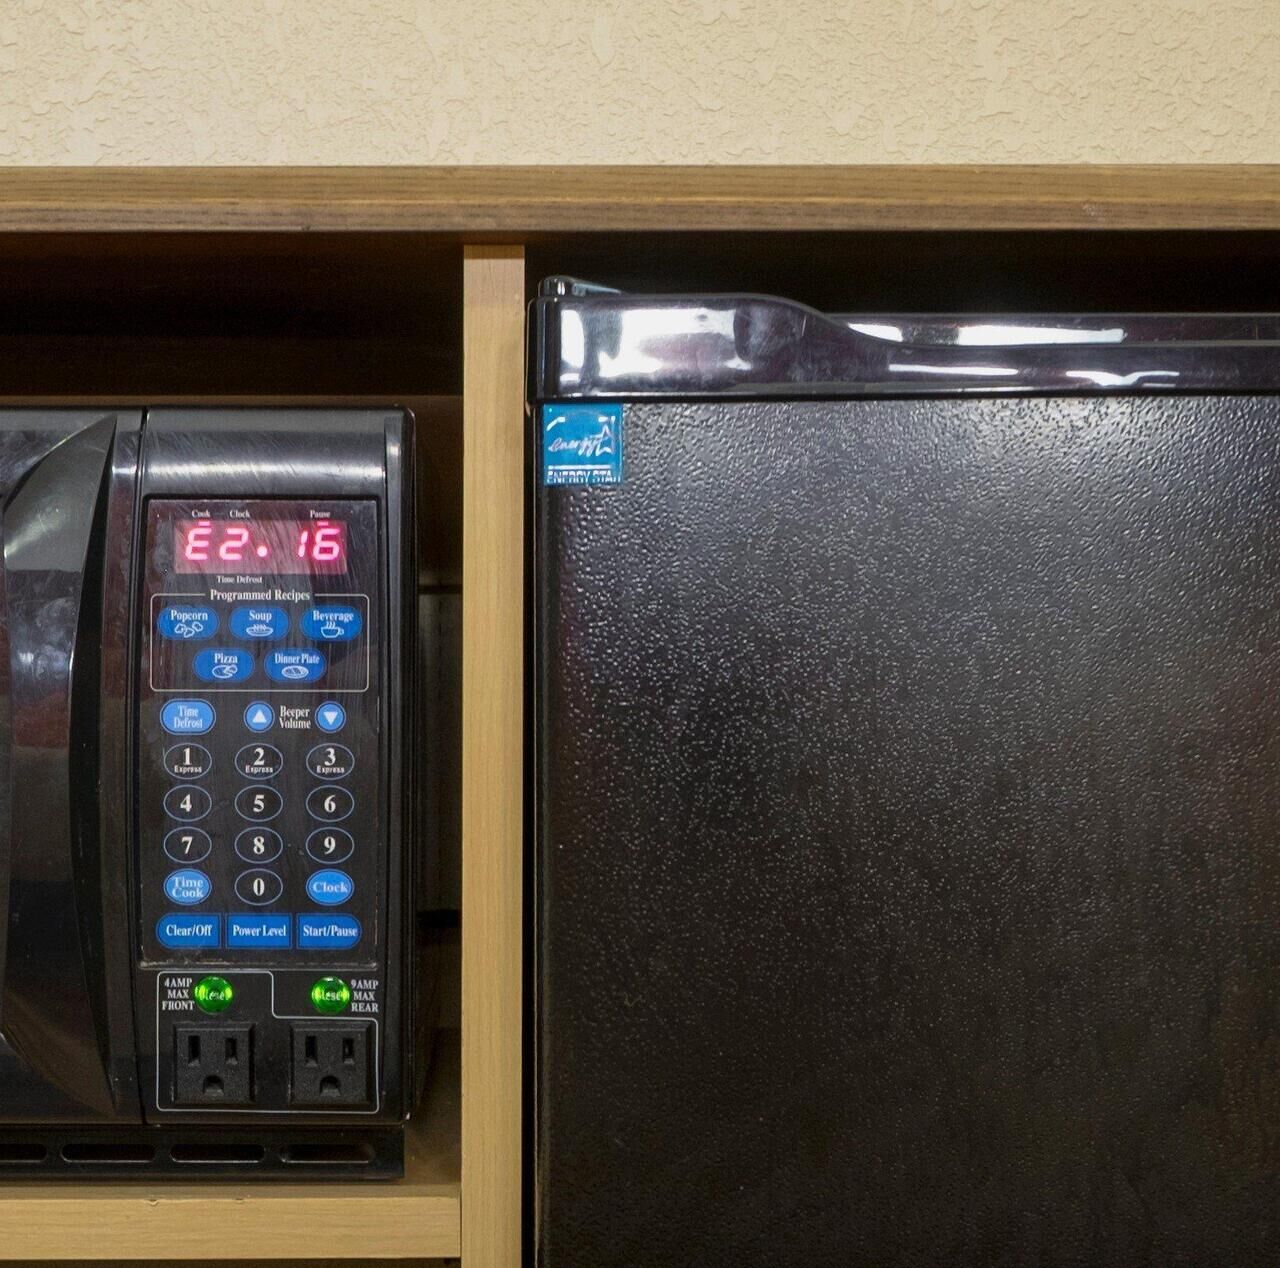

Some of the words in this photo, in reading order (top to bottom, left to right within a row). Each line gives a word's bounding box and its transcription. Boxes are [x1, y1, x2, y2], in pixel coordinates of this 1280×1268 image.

[192, 509, 211, 519] Cook
[229, 509, 251, 519] Clock
[310, 509, 331, 519] Pause
[217, 575, 234, 584] Time
[236, 575, 263, 584] Defrost
[210, 589, 271, 602] Programmed
[274, 589, 311, 602] Recipes
[170, 609, 208, 622] Popcorn
[248, 609, 272, 622] Soup
[312, 610, 354, 622] Beverage
[214, 652, 238, 664] Pizza
[274, 653, 300, 664] Dinner
[301, 653, 320, 664] Plate
[178, 705, 199, 716] Time
[280, 705, 310, 719] Beeper
[173, 717, 203, 729] Defrost
[279, 718, 311, 729] Volume
[183, 747, 191, 766] 1
[253, 747, 265, 766] 2
[324, 747, 337, 766] 3
[174, 765, 202, 774] Express
[245, 765, 273, 774] Express
[316, 765, 345, 774] Express
[180, 794, 193, 813] 4
[253, 794, 265, 813] 5
[323, 794, 336, 813] 6
[181, 836, 193, 854] 7
[253, 835, 265, 855] 8
[323, 836, 336, 855] 9
[173, 877, 203, 888] Time
[252, 877, 265, 897] 0
[312, 882, 349, 893] Clock
[172, 888, 204, 899] Cook
[166, 924, 213, 937] Clear/Off
[232, 924, 262, 937] Power
[262, 924, 287, 937] Level
[303, 924, 358, 937] Start/Pause
[164, 977, 193, 988] 4AMP
[351, 979, 379, 990] 9AMP
[167, 989, 190, 999] MAX
[353, 991, 375, 1001] MAX
[162, 1001, 195, 1011] FRONT
[351, 1003, 379, 1013] REAR
